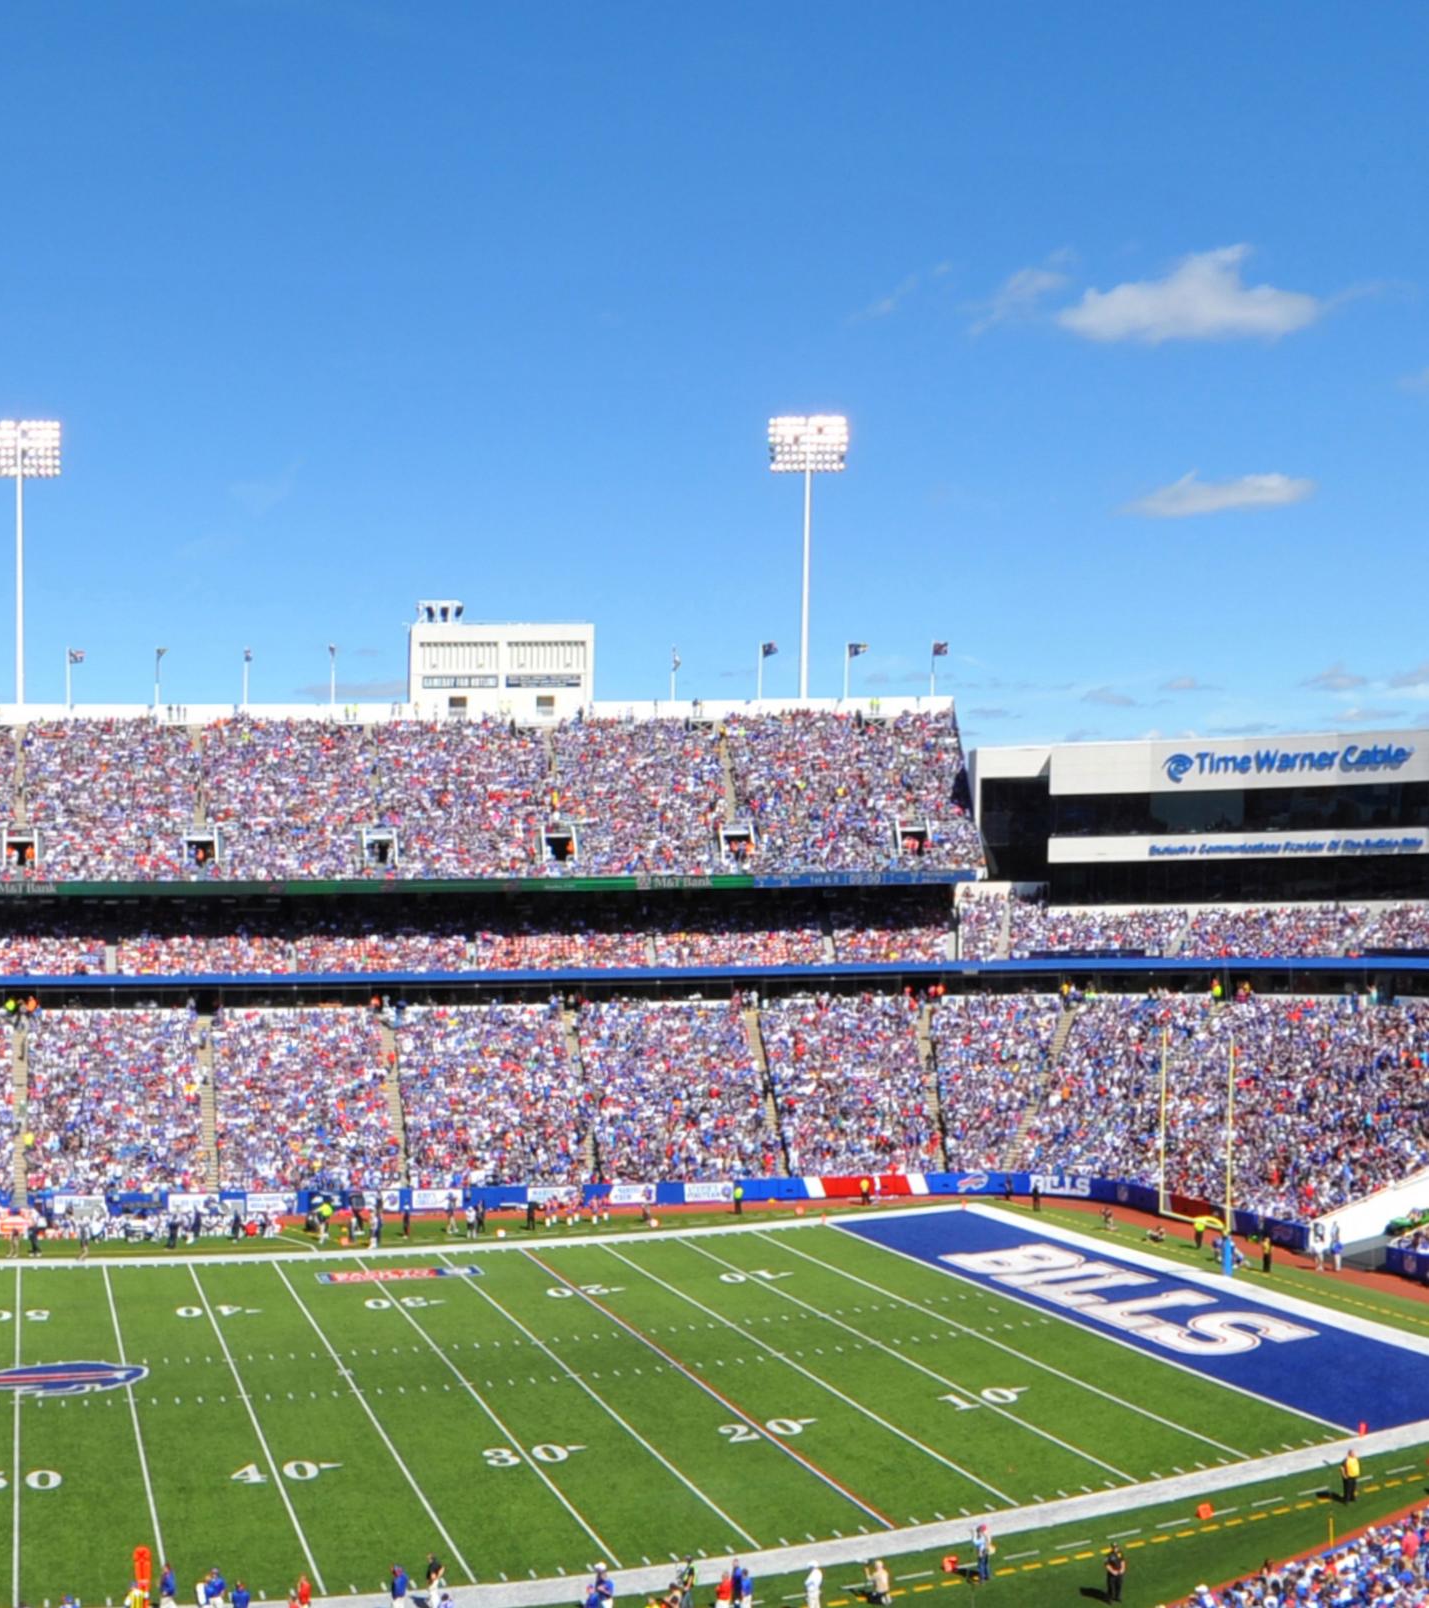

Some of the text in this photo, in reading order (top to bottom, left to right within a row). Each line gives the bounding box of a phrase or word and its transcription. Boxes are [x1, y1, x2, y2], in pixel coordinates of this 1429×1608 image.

[1195, 744, 1412, 774] Time Warner Cable
[27, 882, 57, 894] Bank
[683, 875, 713, 888] Bank
[1029, 1174, 1091, 1197] BILLS
[937, 1242, 1321, 1356] BILLS
[937, 1386, 1019, 1411] 10
[718, 1417, 804, 1443] 20
[482, 1443, 568, 1467] 30
[231, 1460, 321, 1484] 40
